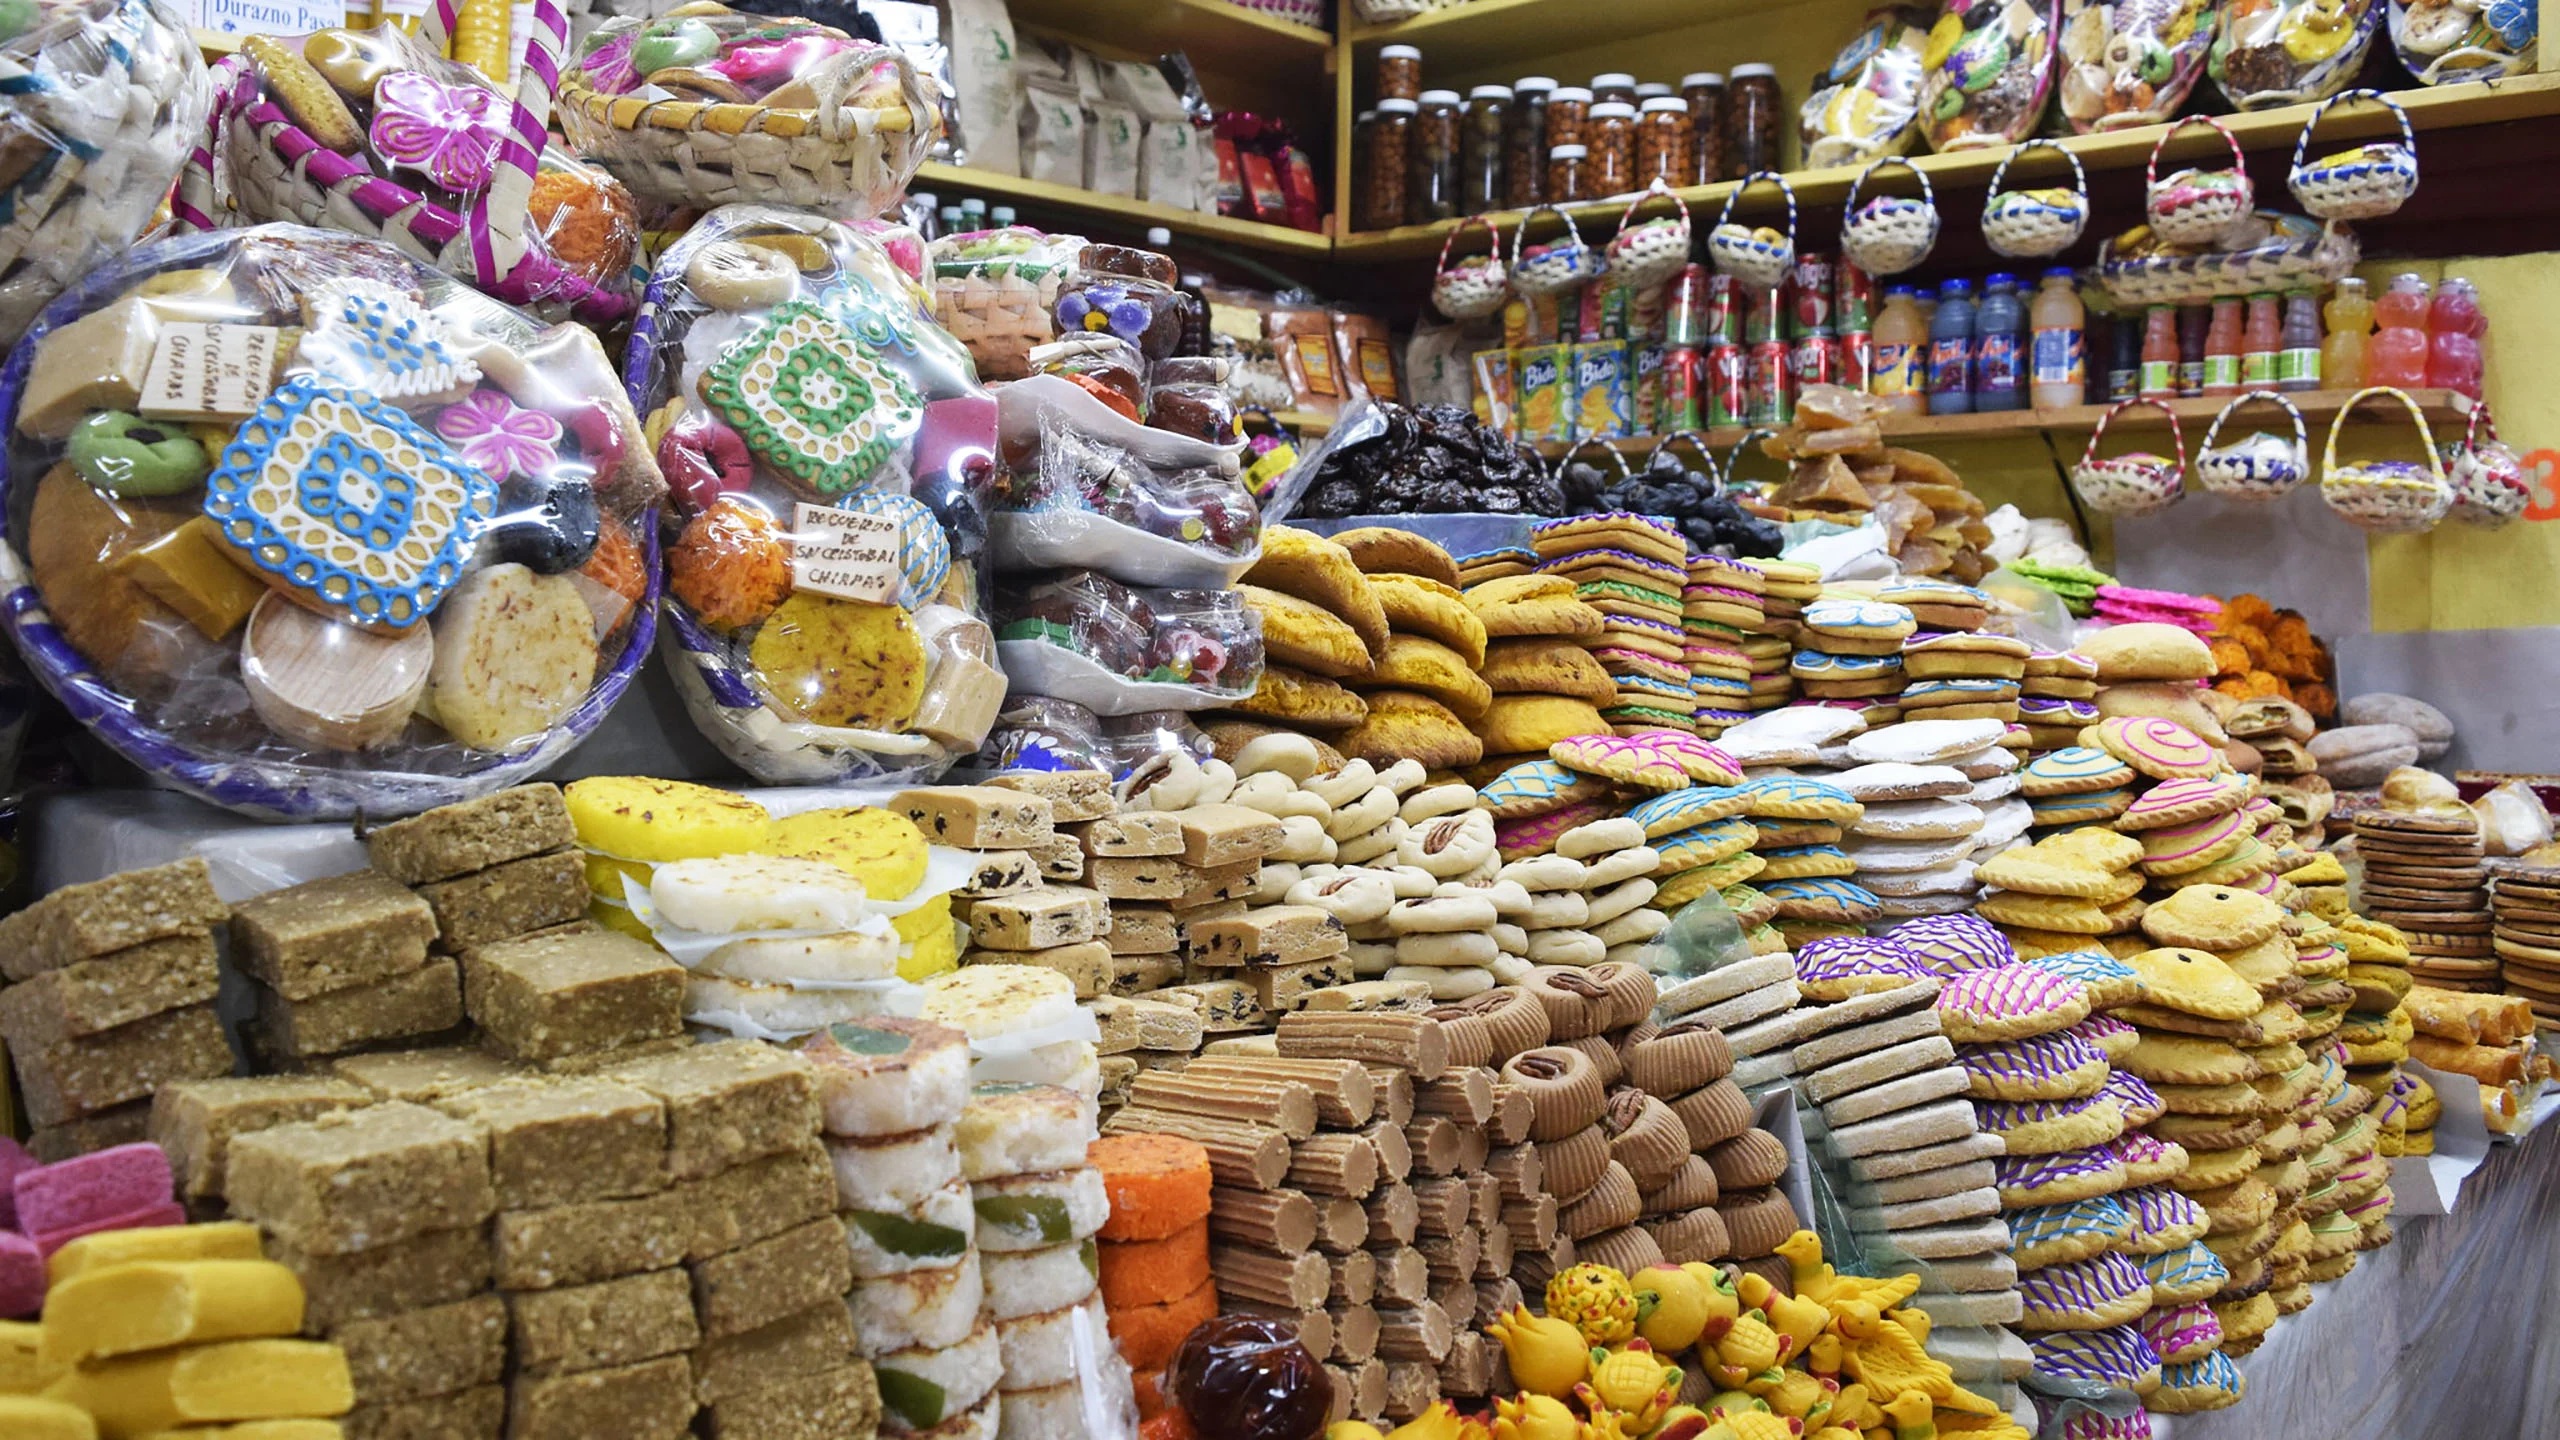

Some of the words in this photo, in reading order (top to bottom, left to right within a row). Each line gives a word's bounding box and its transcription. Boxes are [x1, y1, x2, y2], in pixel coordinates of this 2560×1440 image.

[216, 0, 291, 25] Durazno
[807, 510, 895, 532] RECUERDO
[841, 532, 860, 545] DE
[808, 568, 886, 589] CHIAPAS
